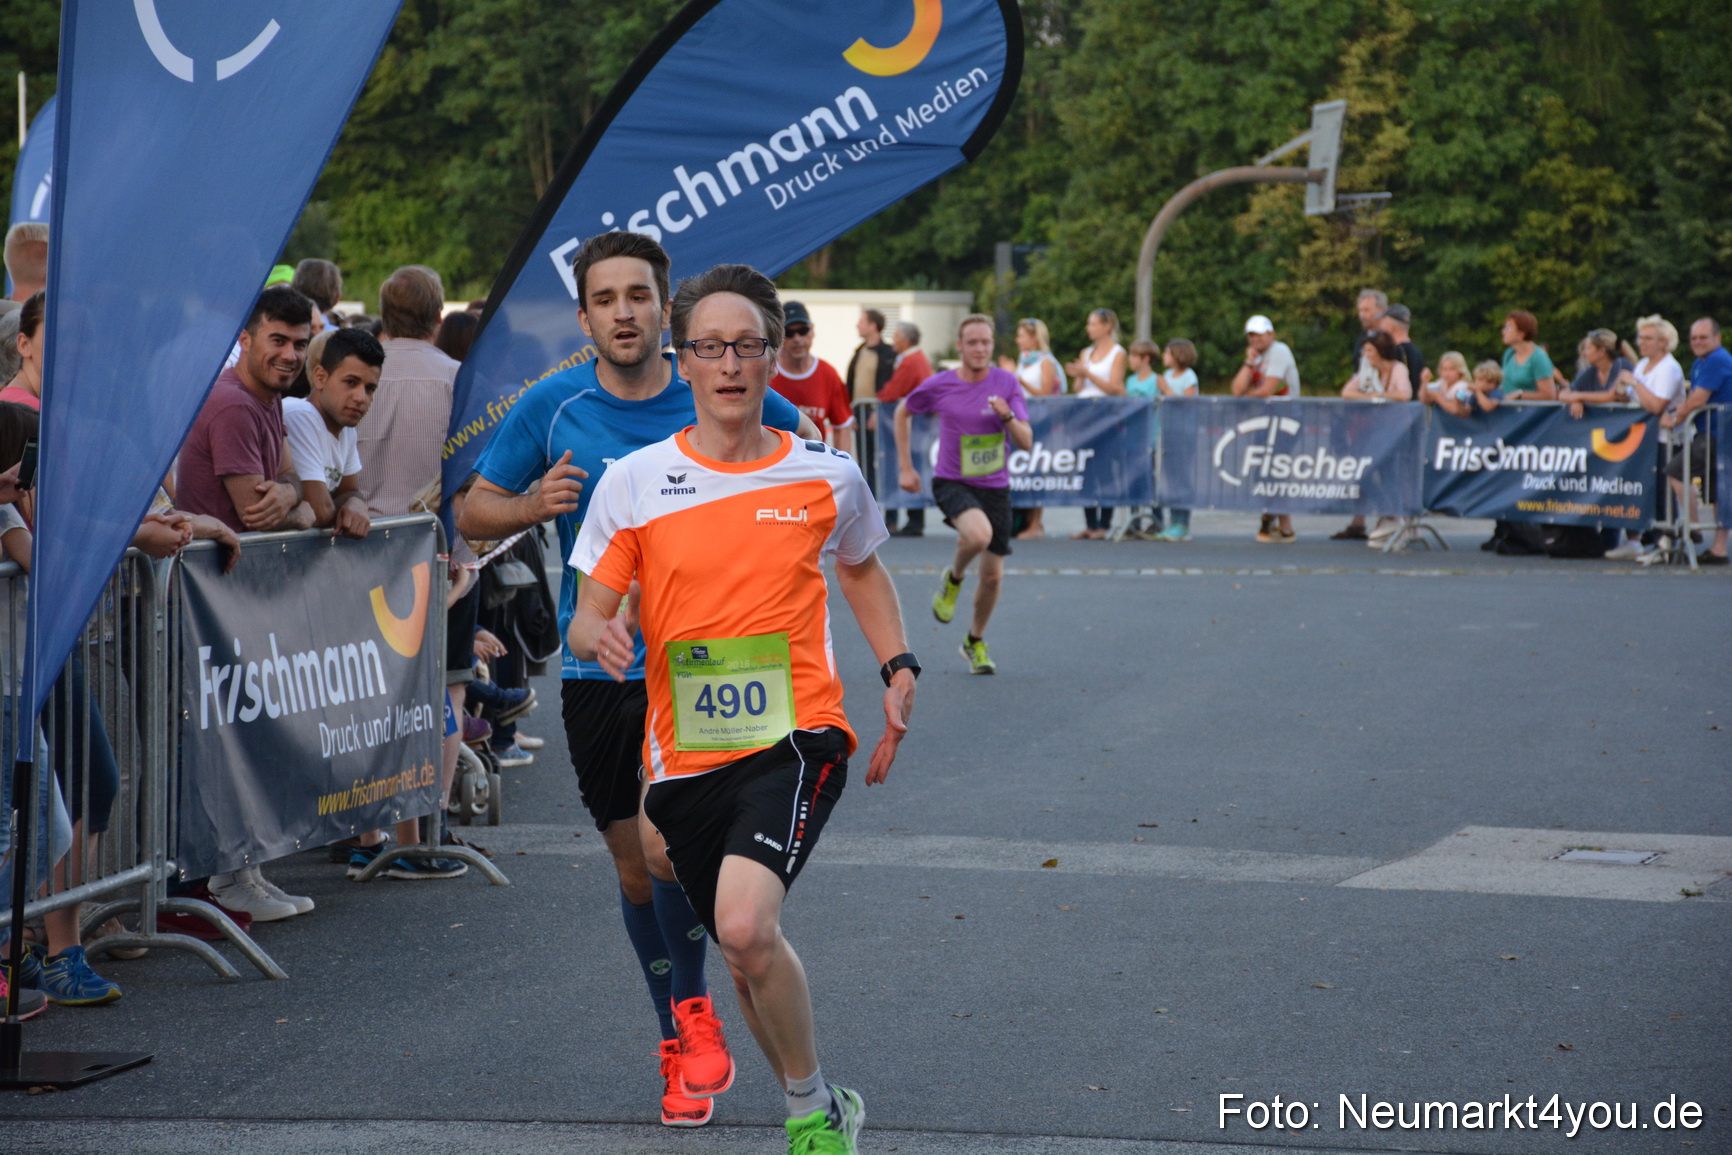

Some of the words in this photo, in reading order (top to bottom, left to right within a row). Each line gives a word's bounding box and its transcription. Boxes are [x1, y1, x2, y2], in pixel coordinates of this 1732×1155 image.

[764, 153, 842, 210] Druck
[844, 124, 898, 161] und
[896, 66, 988, 139] Medien
[549, 86, 879, 300] Fschmann
[1008, 441, 1095, 474] cher
[1242, 445, 1373, 480] Fischer
[1434, 437, 1588, 473] Frischmann
[661, 486, 696, 496] erima
[1009, 475, 1084, 491] MOBILE
[1253, 482, 1360, 499] AUTOMOBILE
[1522, 473, 1556, 491] Druck
[1558, 475, 1588, 492] und
[1590, 476, 1643, 496] Medien
[1516, 499, 1641, 519] www.frischmann-net.de
[198, 633, 386, 730] Frischmann
[695, 681, 767, 718] 490
[319, 714, 361, 758] Druck
[363, 706, 391, 748] und
[699, 727, 719, 735] André
